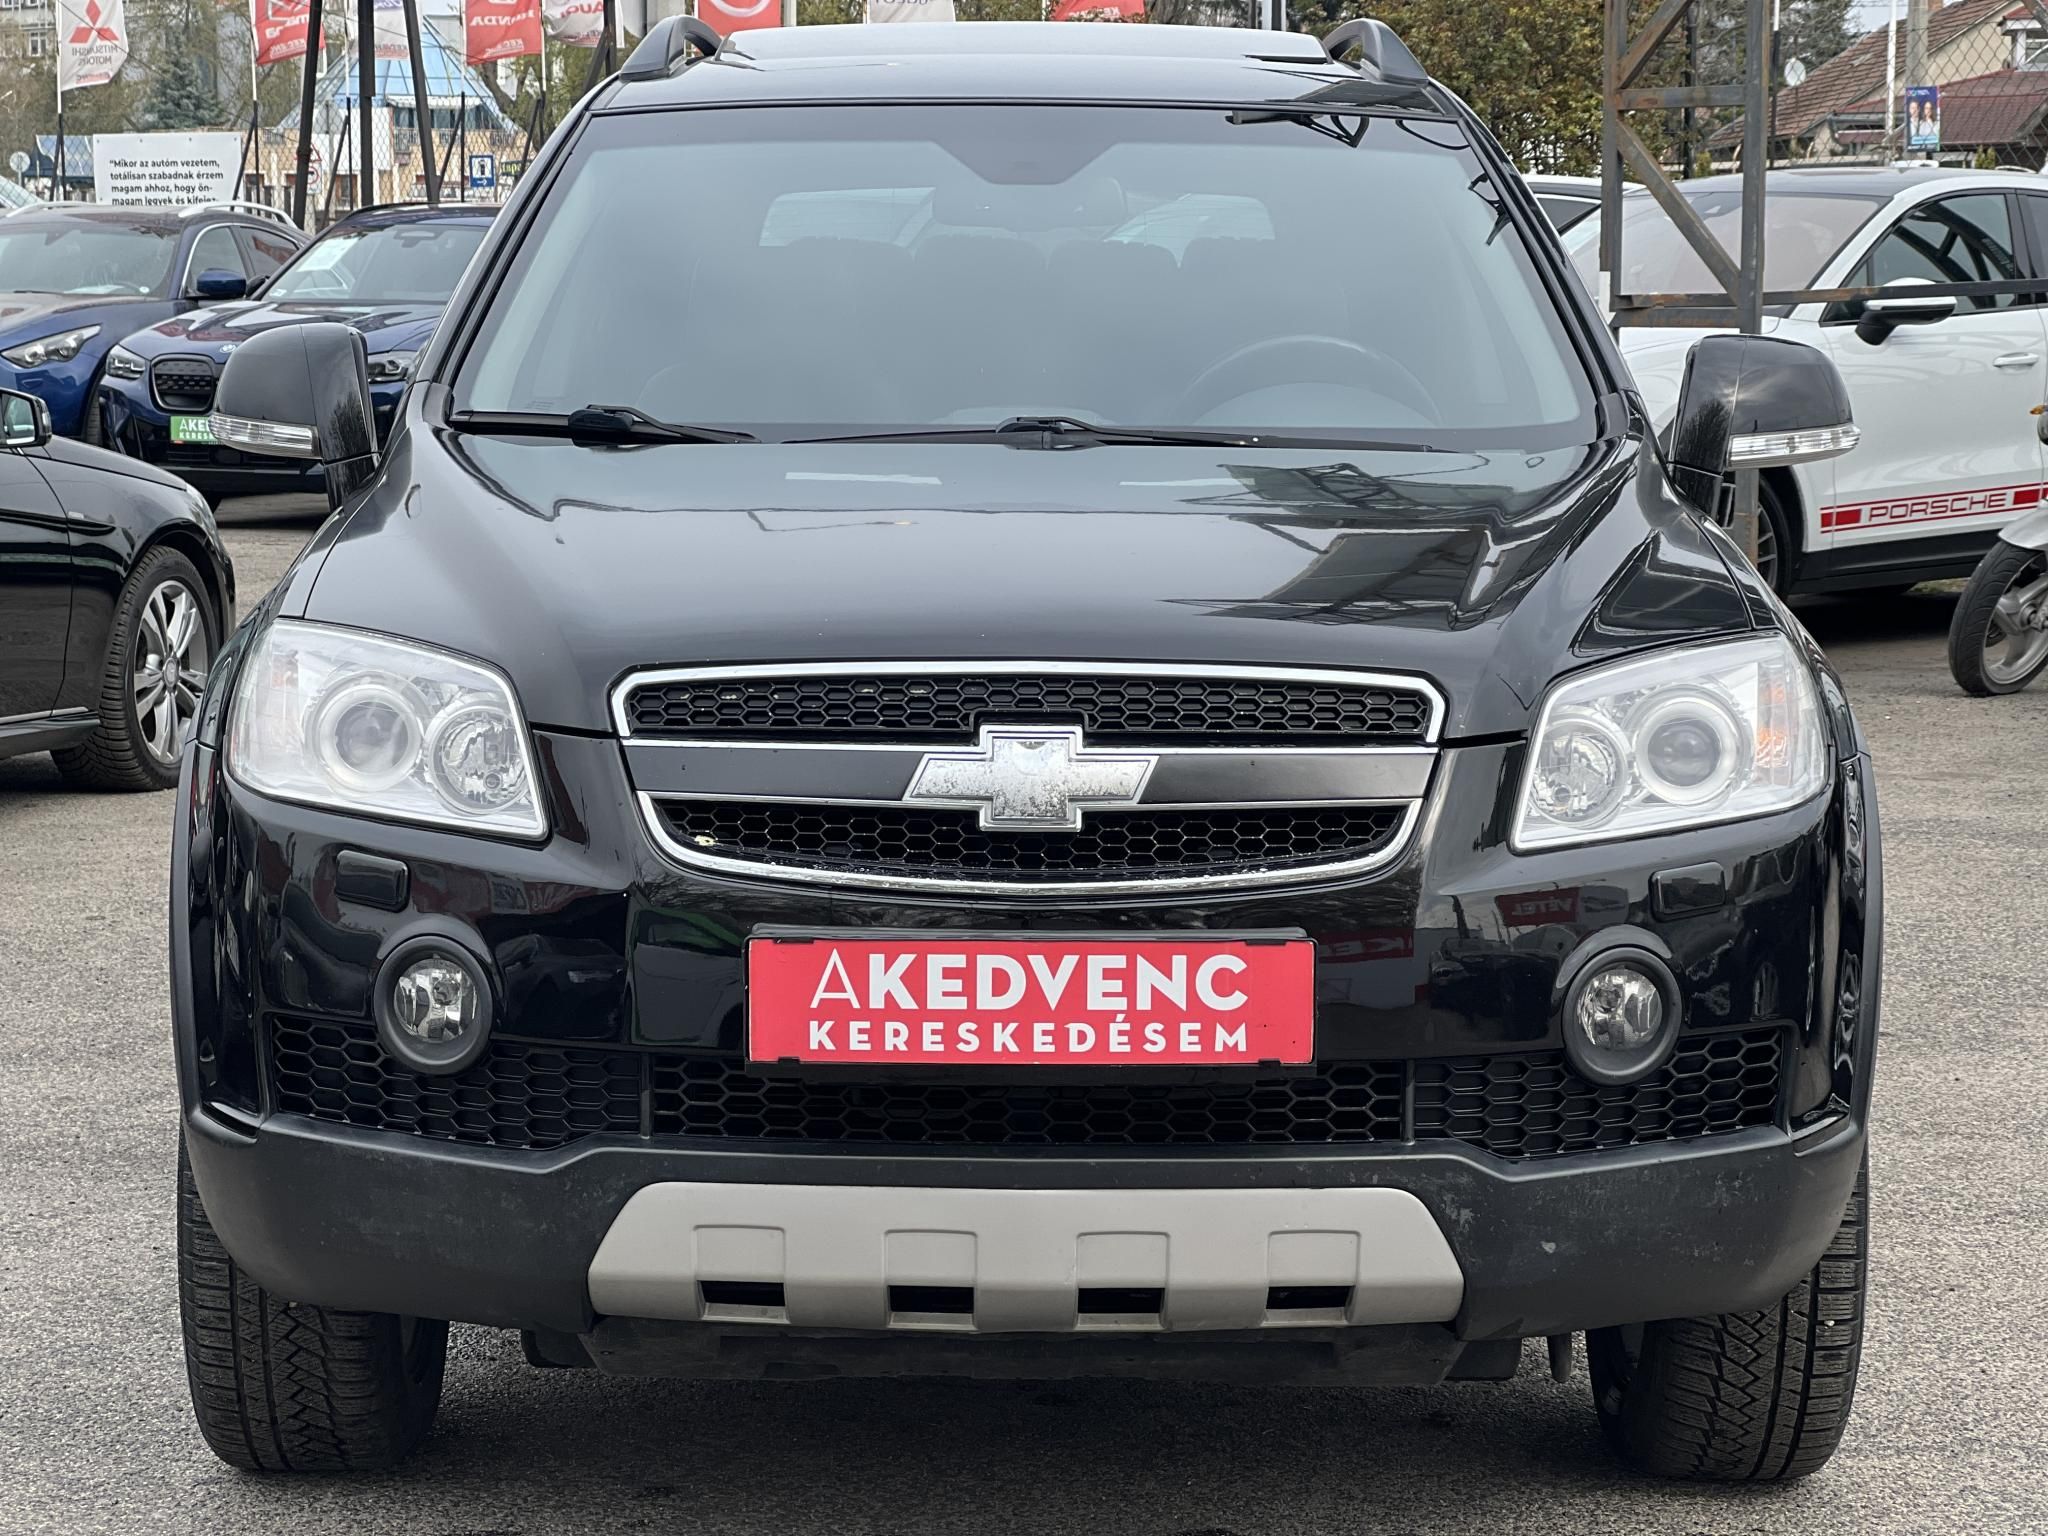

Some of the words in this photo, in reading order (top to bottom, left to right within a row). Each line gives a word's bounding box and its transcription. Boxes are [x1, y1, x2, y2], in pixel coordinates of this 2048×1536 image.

[151, 159, 179, 168] autóm
[180, 160, 220, 168] vezetem,
[110, 171, 147, 180] totálisan
[148, 171, 194, 180] szabadnak
[196, 170, 224, 180] érzem
[111, 186, 143, 195] magam
[144, 184, 173, 193] ahhoz,
[174, 184, 196, 195] hogy
[175, 196, 185, 205] és
[1868, 492, 2008, 522] PORSCHE
[808, 1014, 1248, 1054] KERESKEDÉSEM
